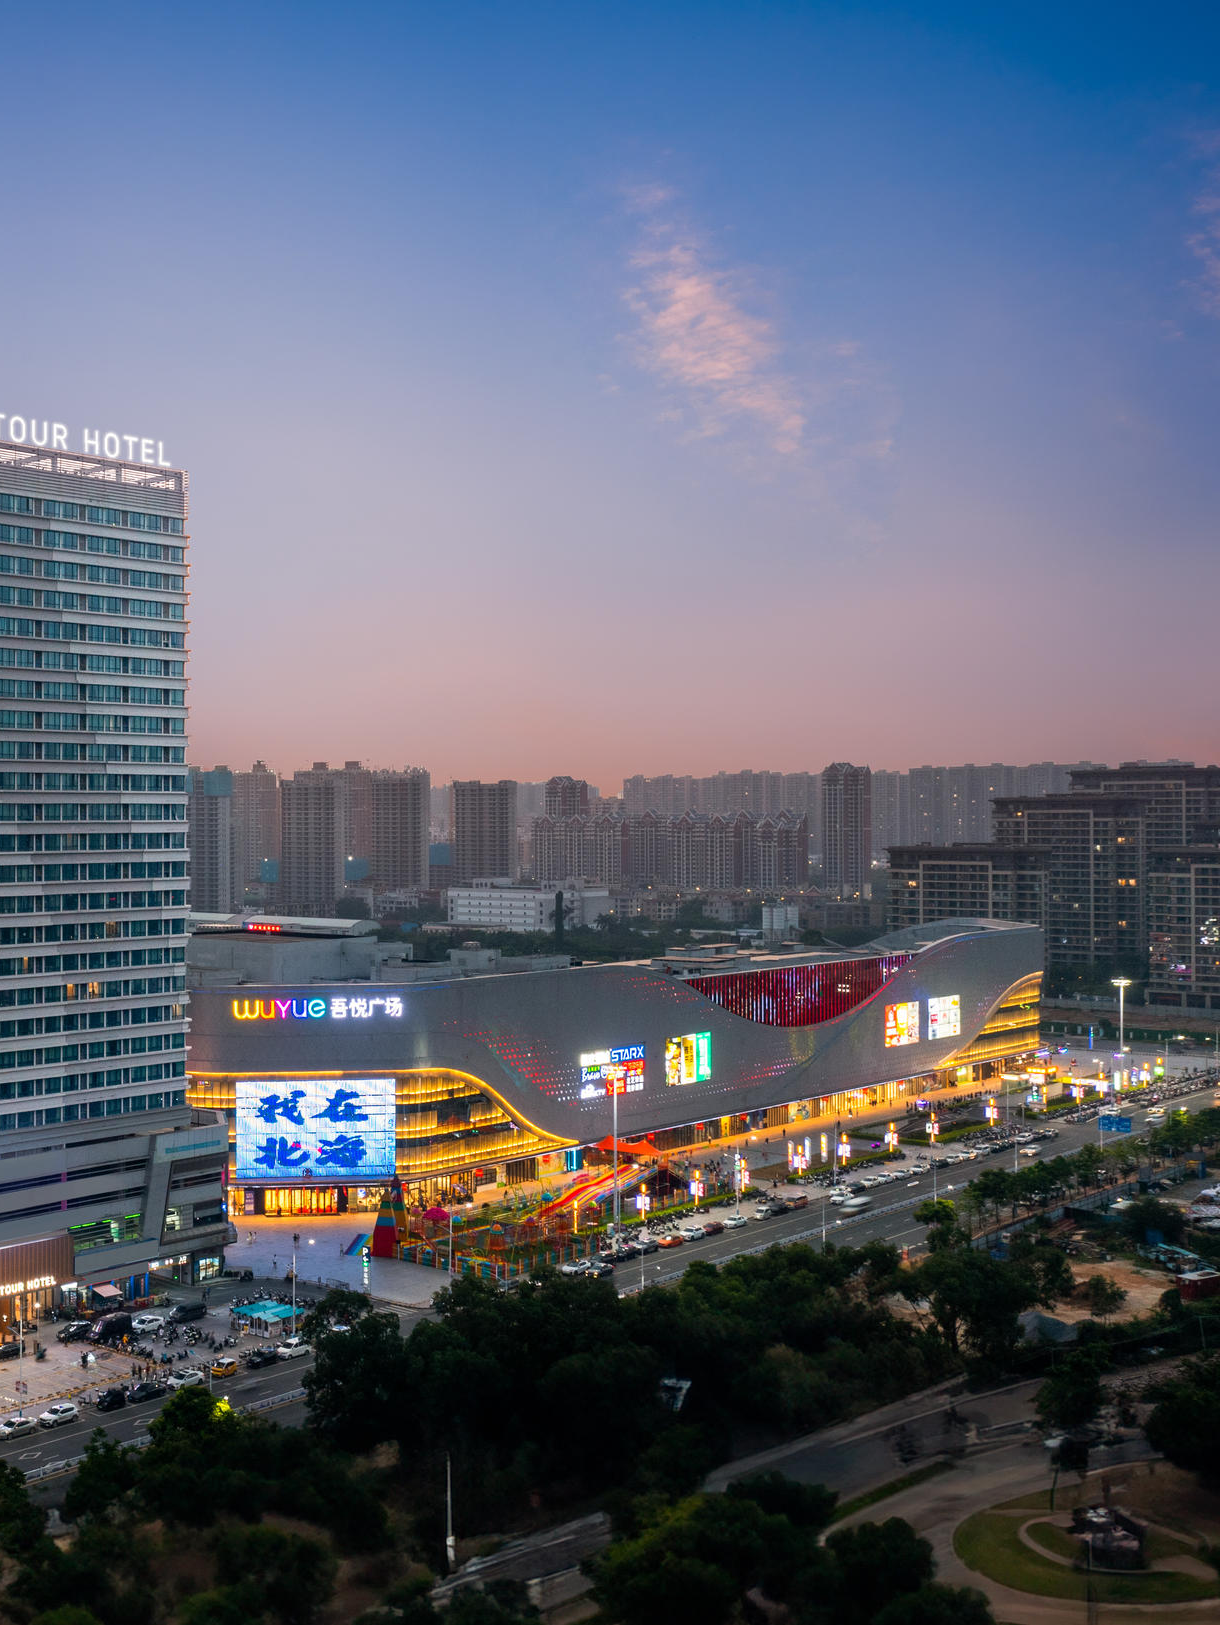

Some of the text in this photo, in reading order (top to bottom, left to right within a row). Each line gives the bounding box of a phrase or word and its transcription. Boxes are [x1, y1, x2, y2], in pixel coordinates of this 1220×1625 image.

[83, 427, 171, 467] HOTEL
[330, 997, 403, 1018] 吾悦广场
[611, 1046, 644, 1062] STARX
[255, 1088, 369, 1126] 我在
[253, 1134, 368, 1170] 北海
[27, 1275, 57, 1290] HOTEL
